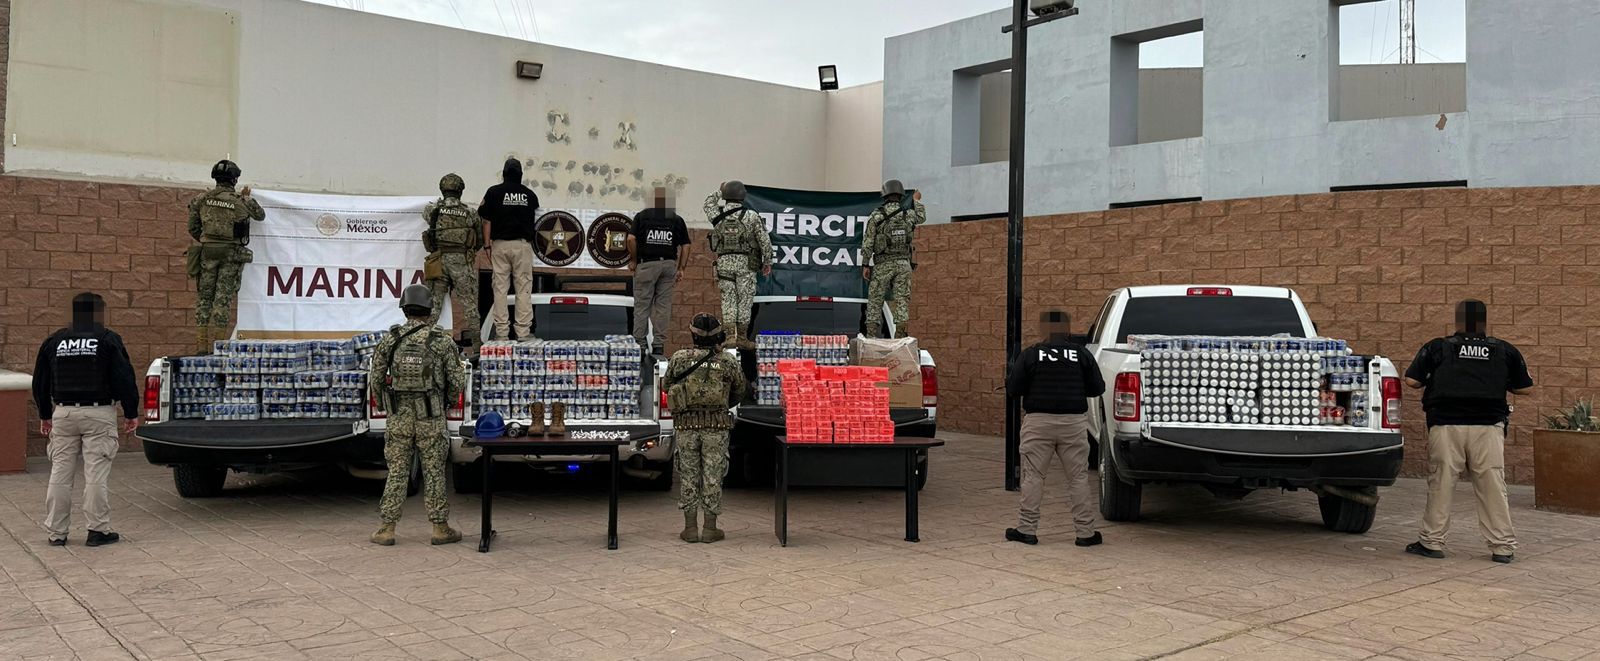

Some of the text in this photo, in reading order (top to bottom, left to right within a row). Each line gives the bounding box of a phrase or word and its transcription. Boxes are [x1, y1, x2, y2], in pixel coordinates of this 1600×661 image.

[503, 192, 528, 201] AMIC
[206, 199, 235, 209] MARINA
[440, 208, 467, 217] MARINA
[759, 207, 870, 237] JÉRCIT
[346, 224, 387, 233] México
[647, 229, 672, 241] AMIC
[57, 338, 98, 350] AMIC
[1460, 344, 1490, 357] AMIC
